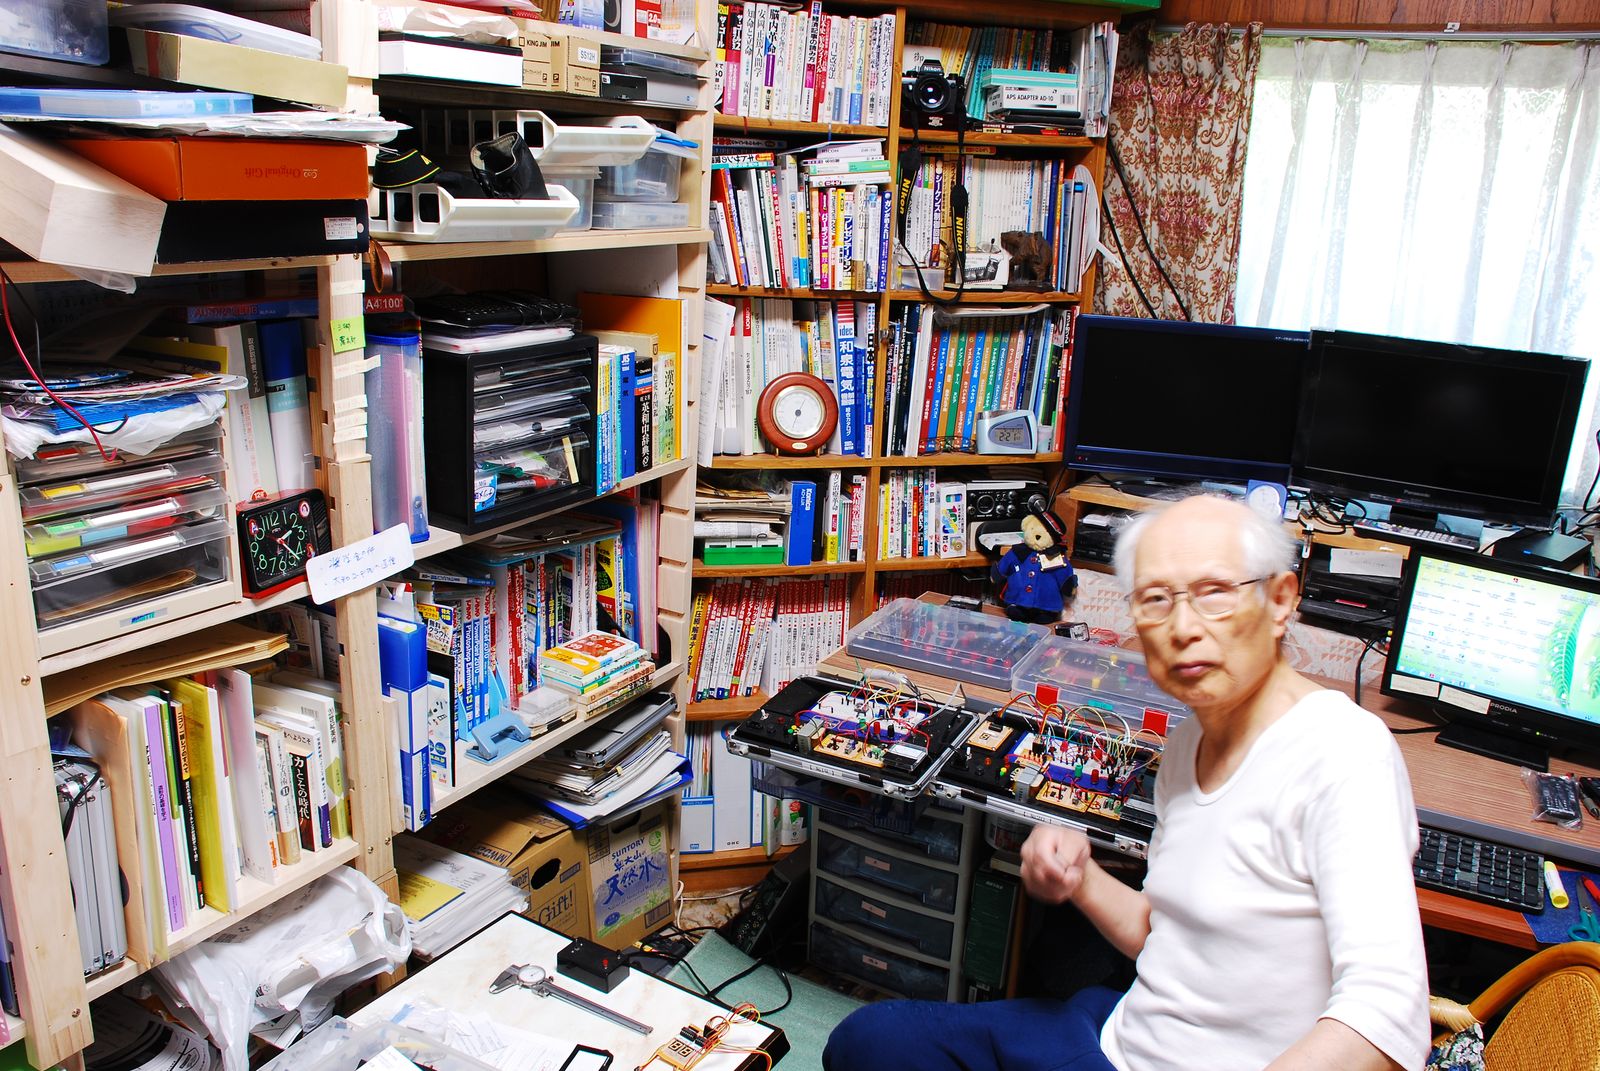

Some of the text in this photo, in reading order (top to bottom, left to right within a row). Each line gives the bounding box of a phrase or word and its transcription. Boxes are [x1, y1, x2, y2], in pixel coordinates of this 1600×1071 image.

[768, 8, 780, 54] 脳内革命
[244, 167, 301, 179] Original Gift
[899, 178, 911, 215] Nikon
[839, 324, 853, 337] idec
[621, 353, 630, 364] JIS
[664, 370, 675, 422] 漢字源
[641, 402, 650, 458] 英和中辞典
[260, 515, 270, 532] 11
[270, 511, 280, 527] 12
[282, 510, 287, 525] 1
[289, 512, 298, 529] 2
[297, 526, 305, 541] 3
[250, 542, 259, 558] 9
[296, 541, 303, 555] 4
[259, 554, 267, 570] 8
[269, 557, 277, 574] 7
[279, 556, 287, 571] 6
[1490, 702, 1518, 714] PRODIA
[294, 756, 311, 819] 力とその時代
[611, 837, 646, 860] SUNTORY
[603, 857, 662, 906] 天然水
[538, 889, 574, 924] Gift!
